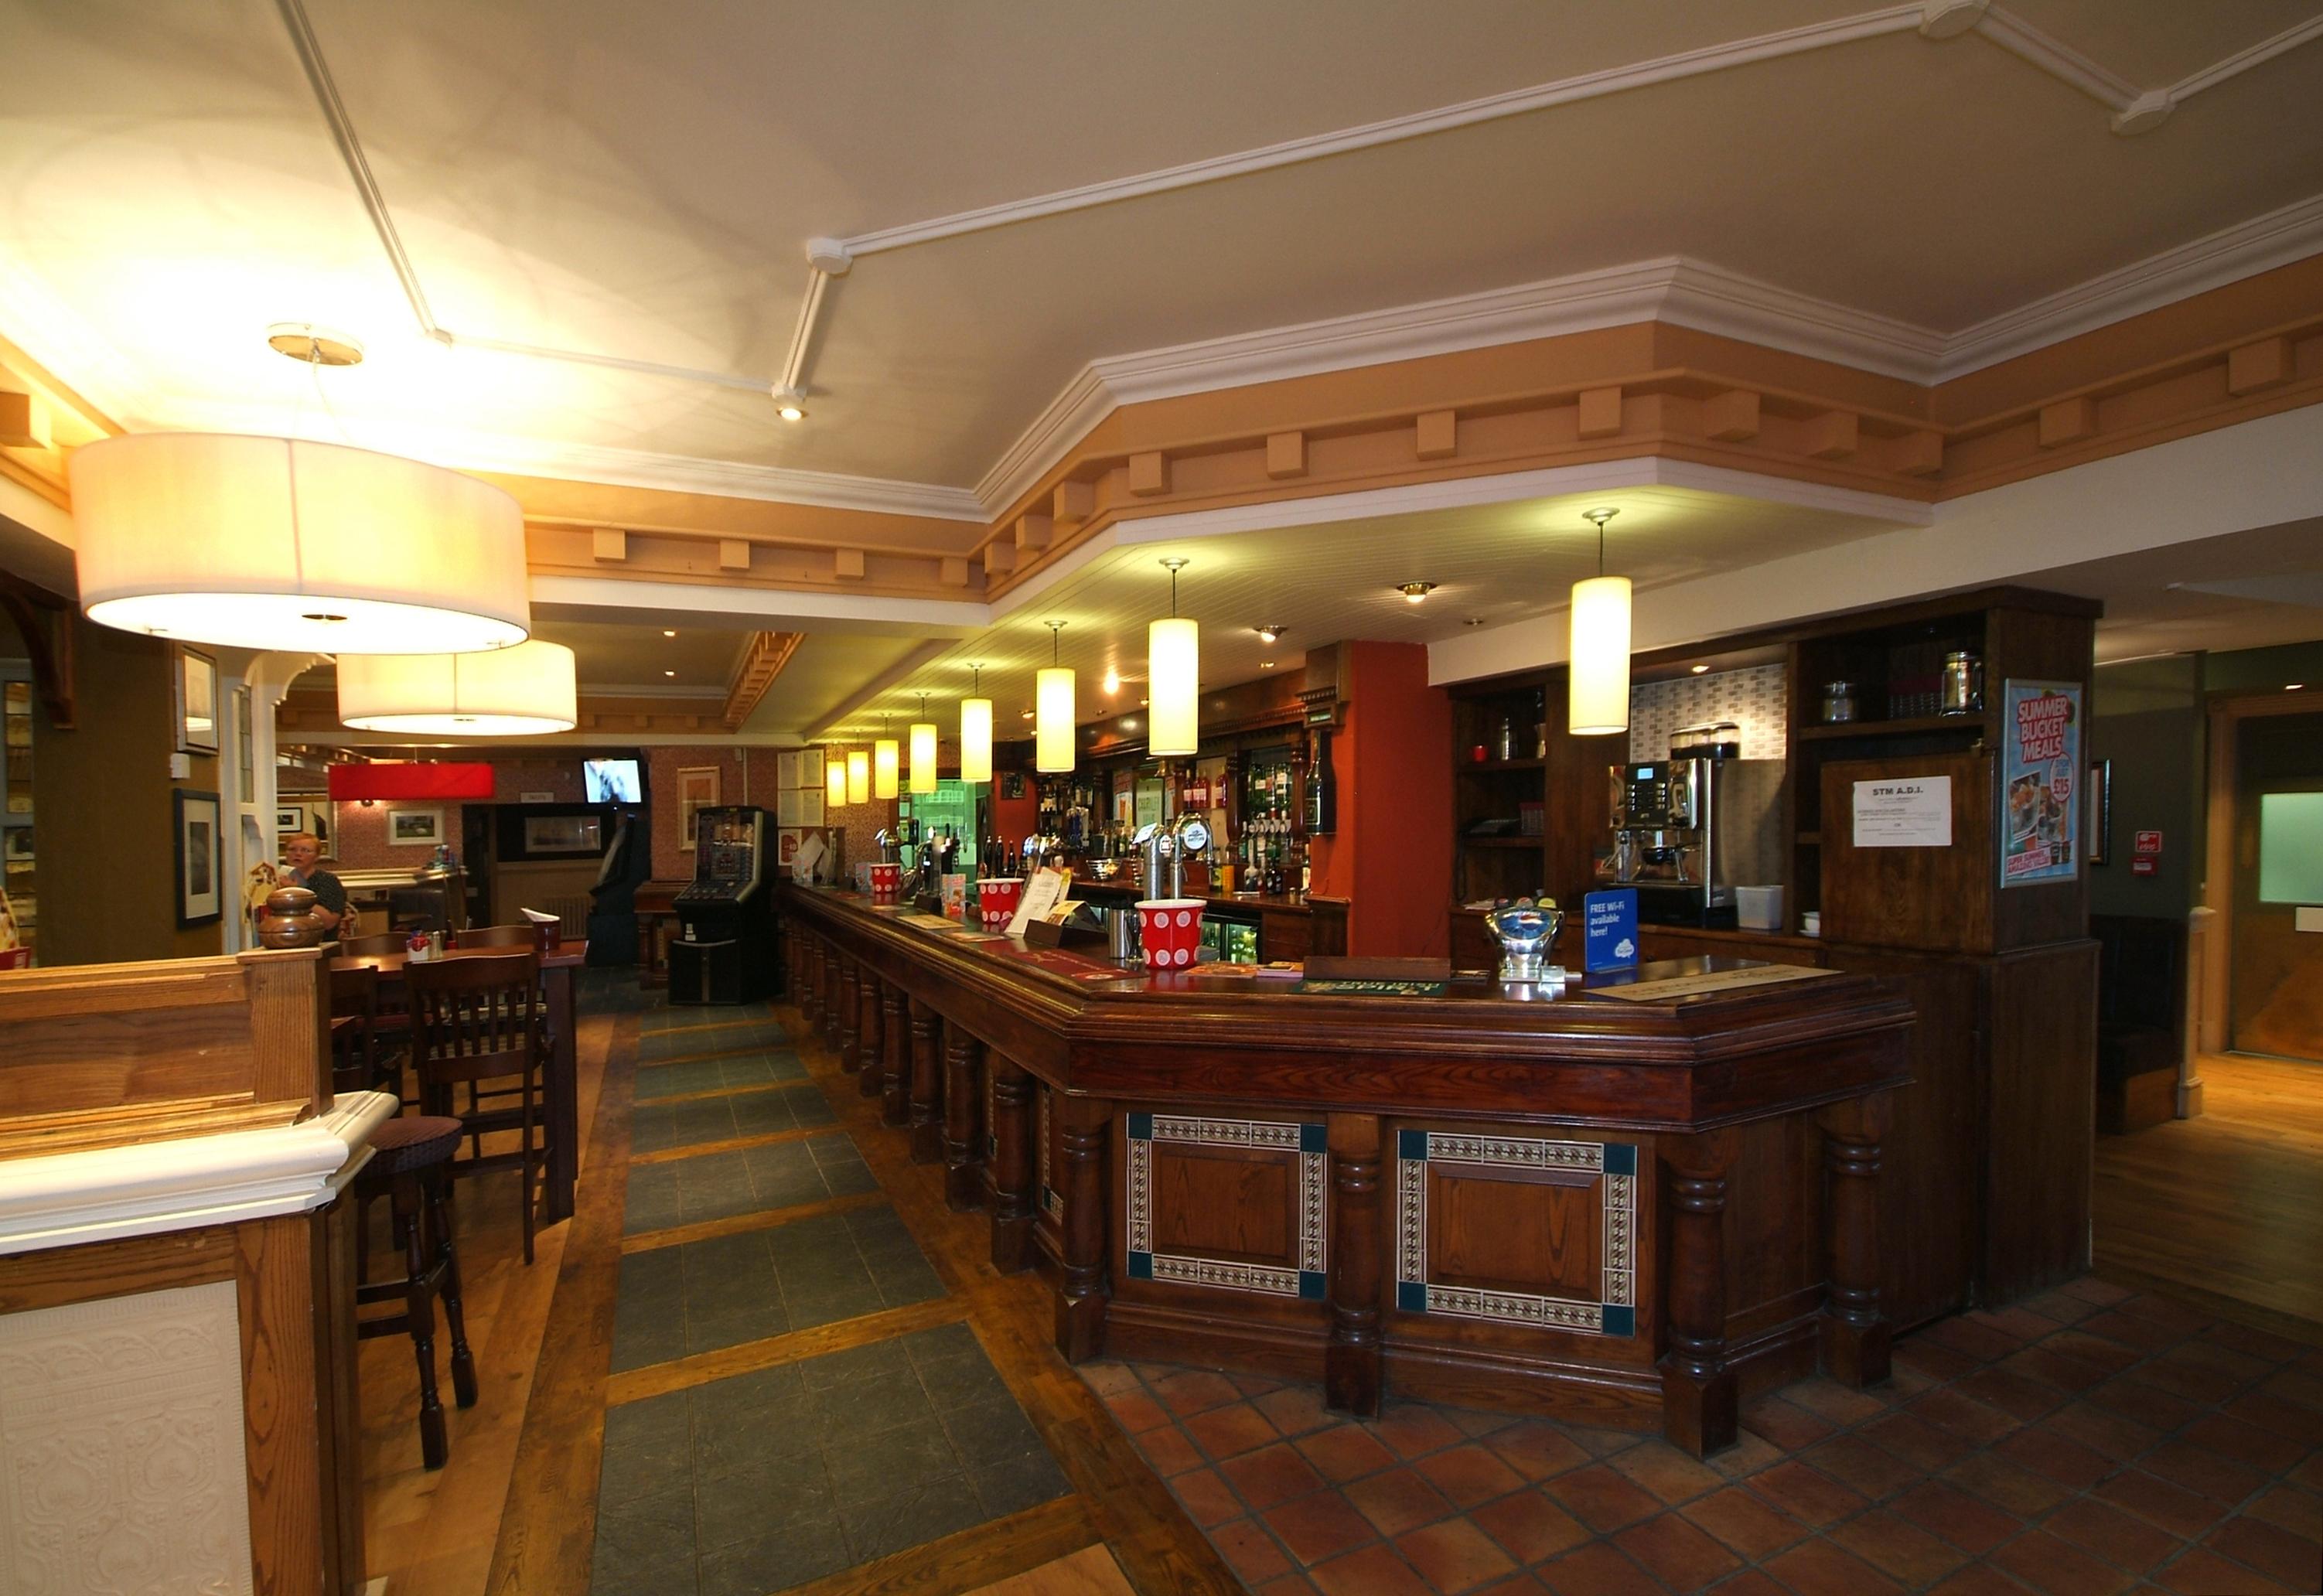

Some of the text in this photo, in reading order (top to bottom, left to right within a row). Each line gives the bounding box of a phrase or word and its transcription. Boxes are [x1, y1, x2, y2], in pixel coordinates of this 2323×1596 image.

[2018, 697, 2068, 723] SUMMER
[2021, 717, 2065, 742] BUCKET
[2024, 735, 2062, 762] MEALS
[1873, 786, 1923, 796] STM A.D.I.
[2054, 778, 2069, 794] £15
[1590, 900, 1625, 913] FREE Wi-Fi
[1590, 913, 1620, 926] available
[1590, 926, 1608, 936] here!
